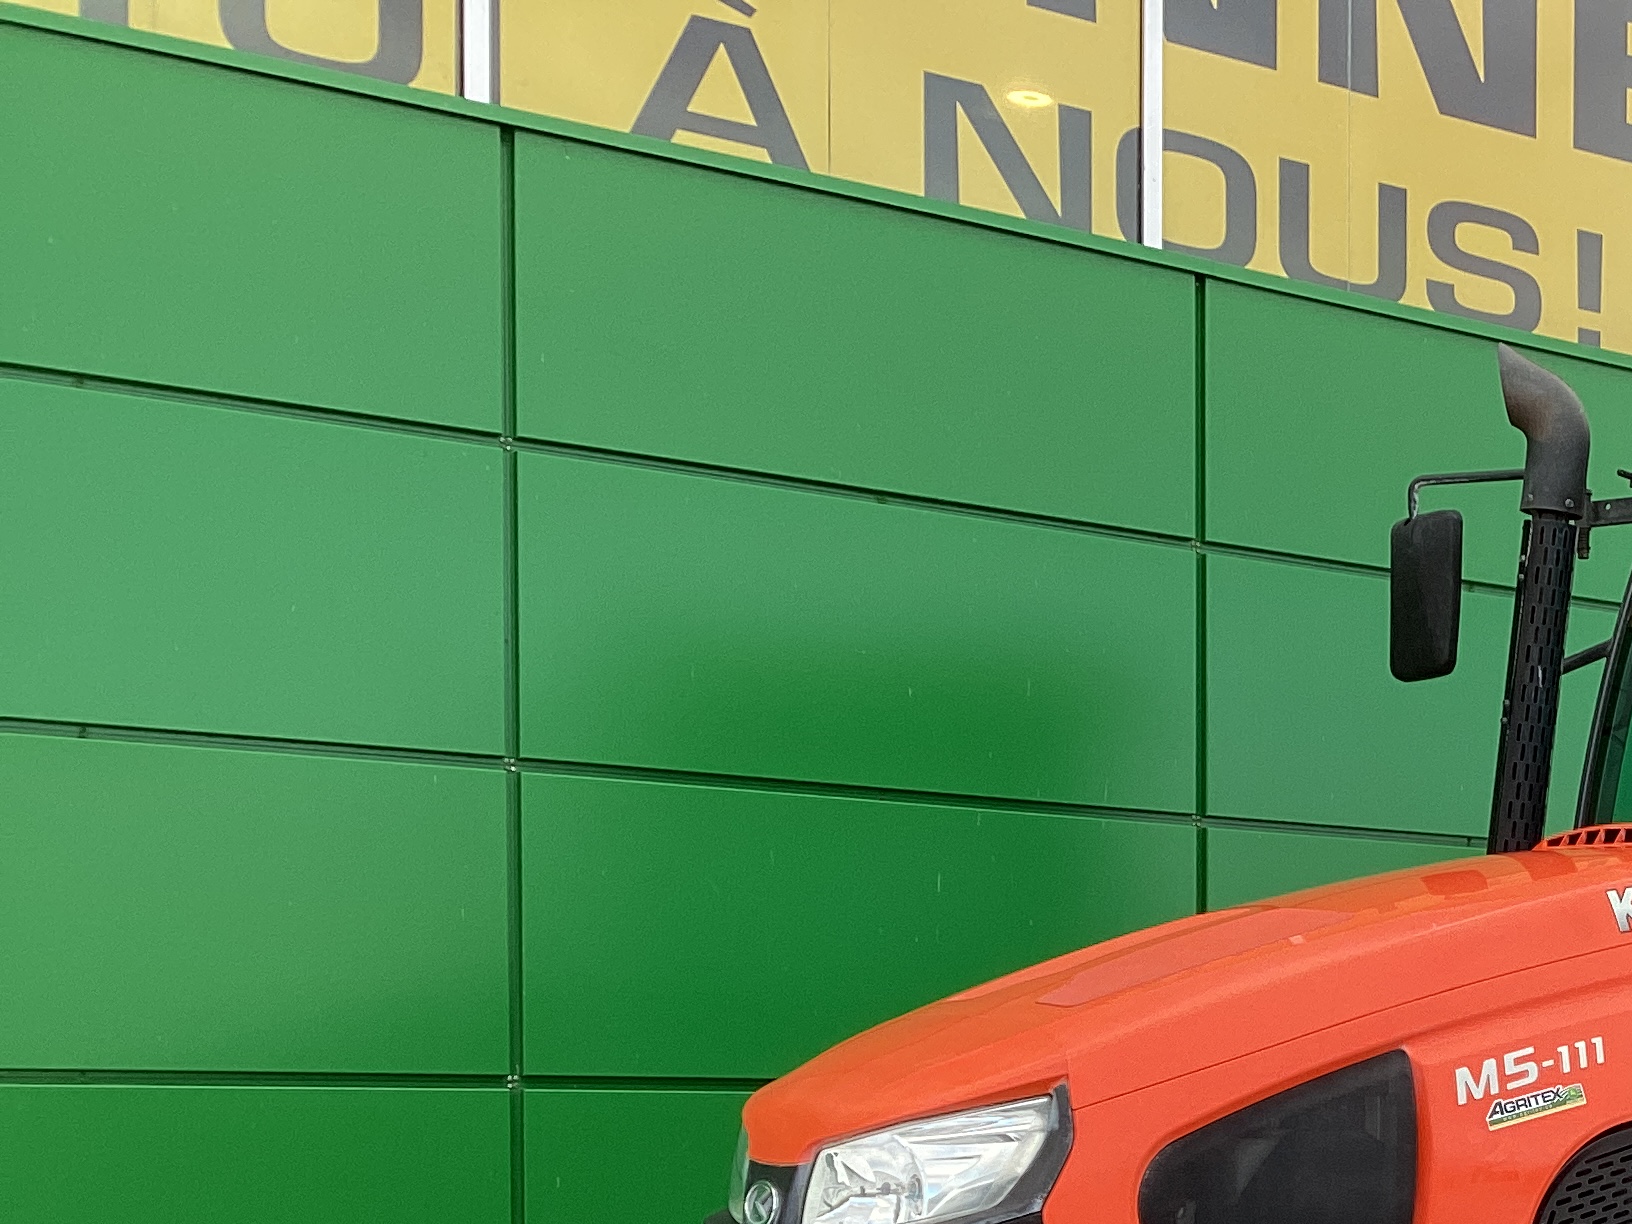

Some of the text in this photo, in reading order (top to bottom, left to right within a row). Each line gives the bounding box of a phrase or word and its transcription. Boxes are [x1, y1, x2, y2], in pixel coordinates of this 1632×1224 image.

[923, 70, 1603, 348] NOUS!
[1454, 1035, 1606, 1106] M5-111
[1488, 1086, 1564, 1119] AGRITEX
